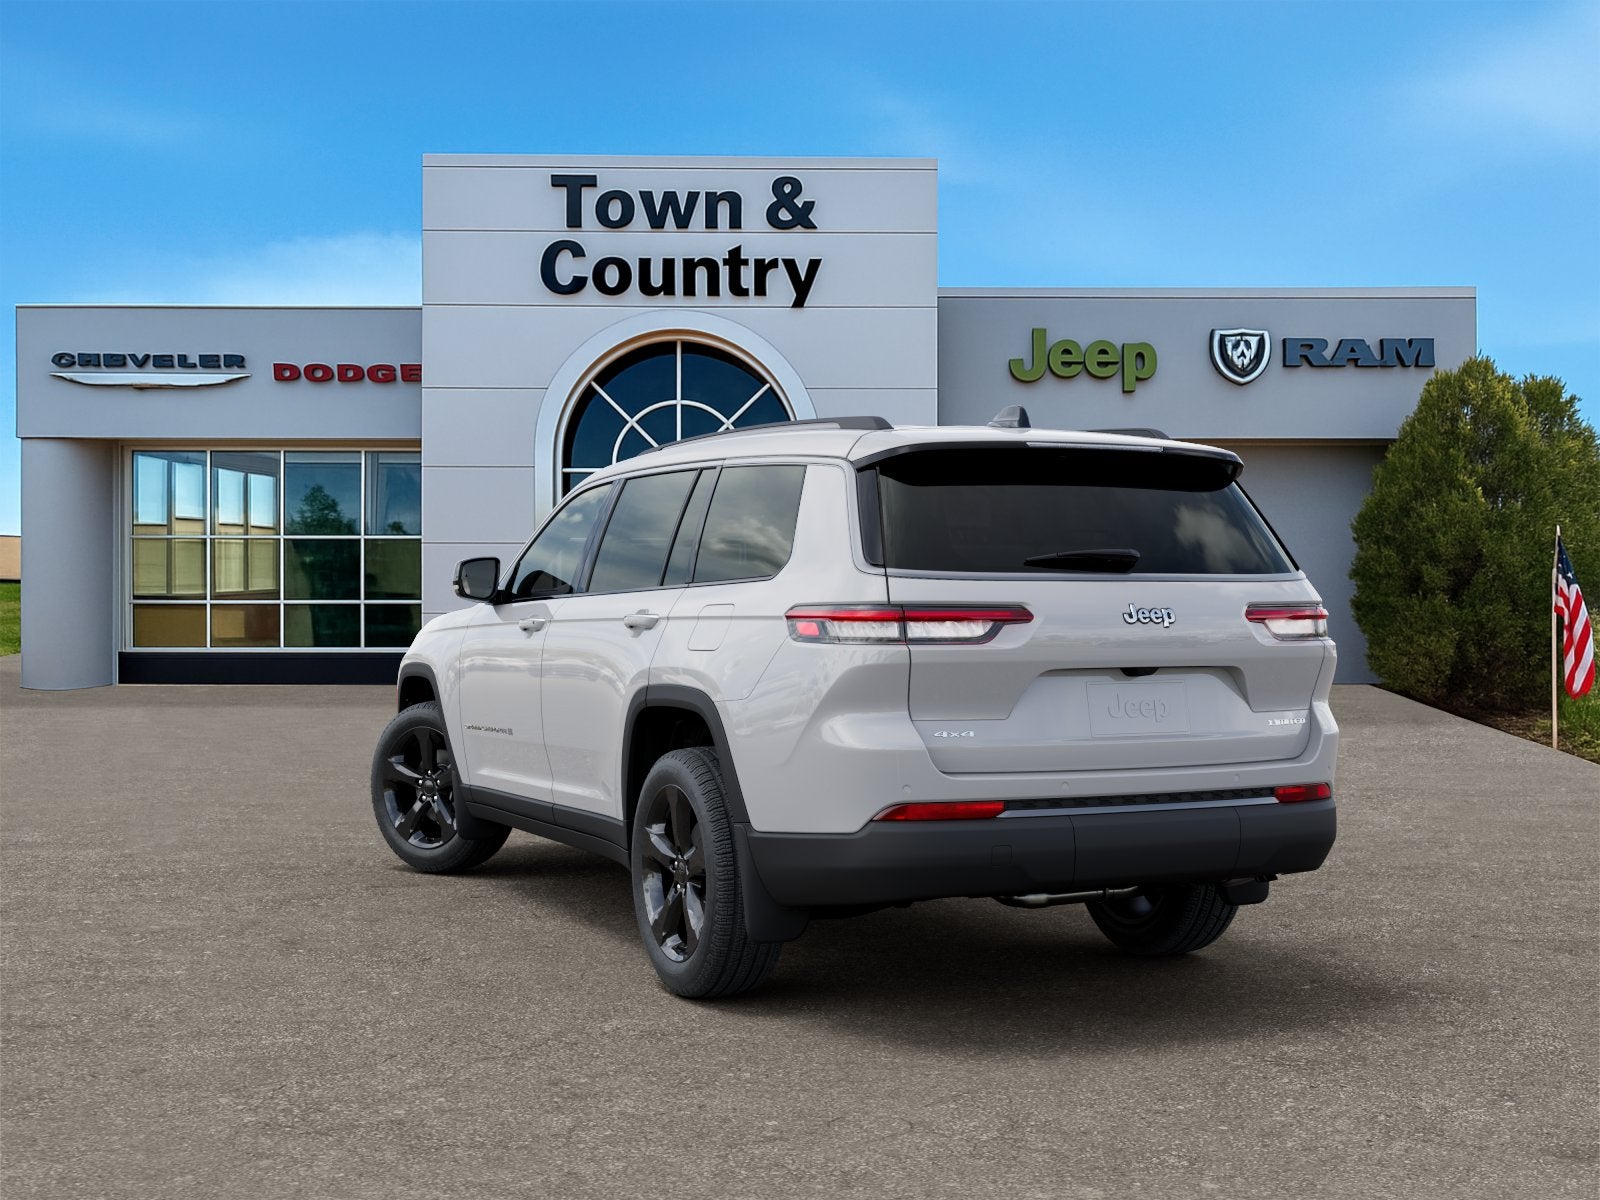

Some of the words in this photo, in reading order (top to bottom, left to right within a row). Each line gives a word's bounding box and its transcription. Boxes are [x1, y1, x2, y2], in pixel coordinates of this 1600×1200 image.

[550, 174, 743, 230] Town
[765, 176, 818, 230] &
[540, 239, 822, 308] Country
[1008, 327, 1158, 392] Jeep
[1282, 337, 1436, 368] RAM
[272, 362, 422, 383] DODGE
[1122, 603, 1176, 628] Jeep
[1107, 687, 1168, 723] Jeep
